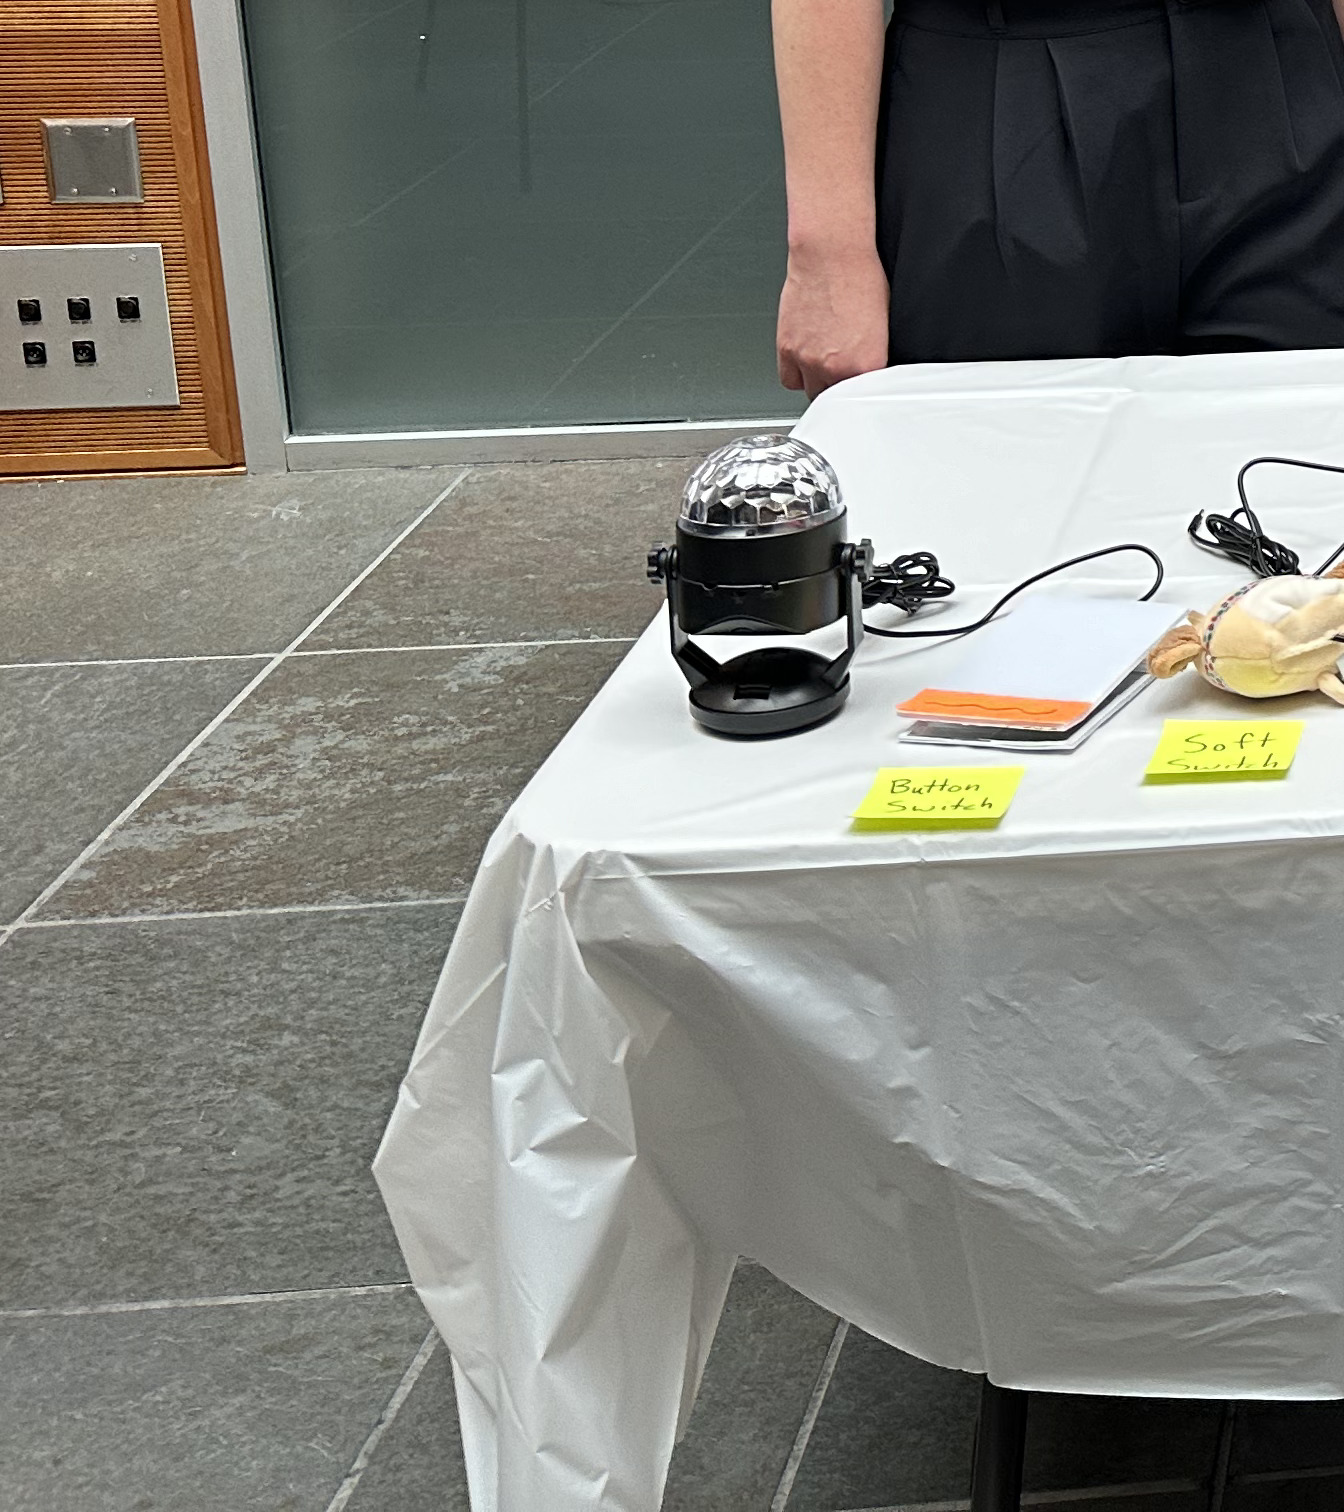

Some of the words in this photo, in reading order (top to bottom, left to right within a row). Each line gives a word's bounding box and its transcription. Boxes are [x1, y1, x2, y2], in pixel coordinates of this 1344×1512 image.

[1184, 732, 1277, 753] Soft
[1168, 753, 1278, 770] Switch
[890, 778, 980, 794] Button
[885, 797, 993, 813] Switch
